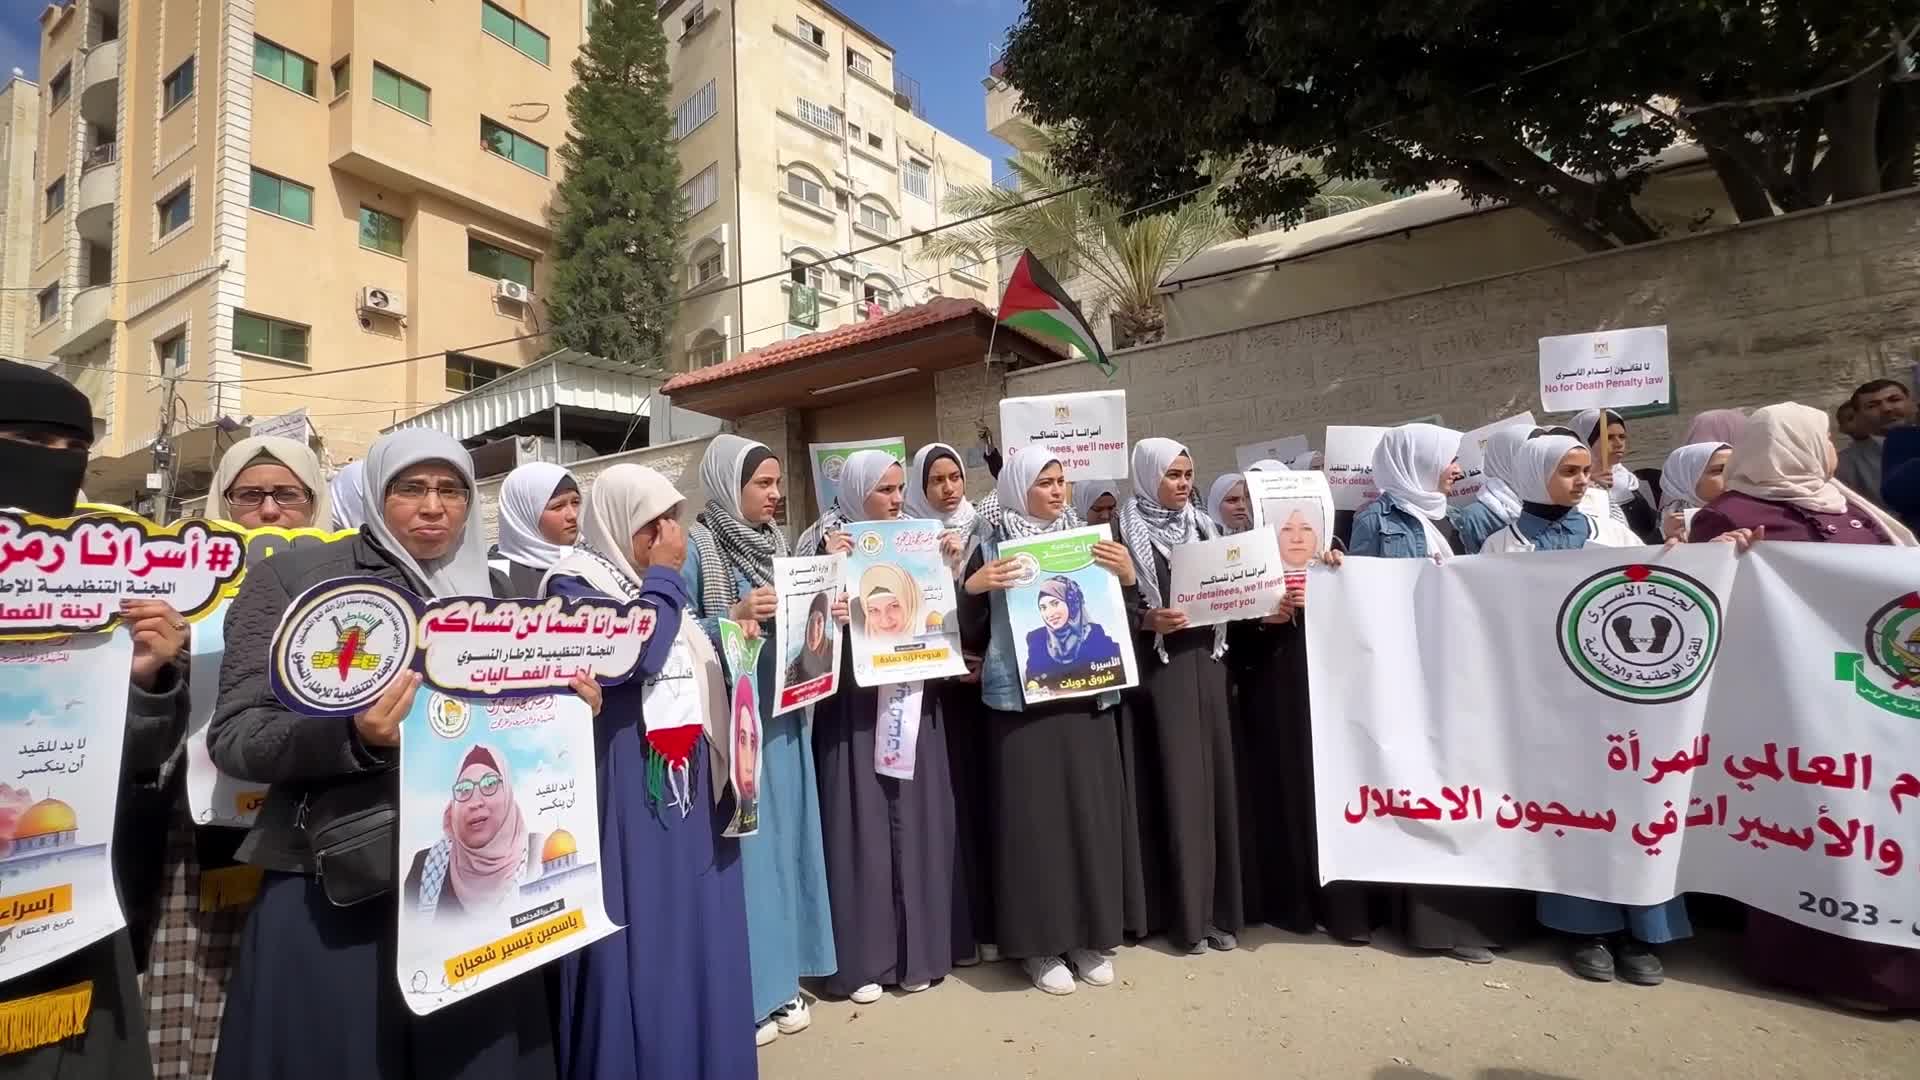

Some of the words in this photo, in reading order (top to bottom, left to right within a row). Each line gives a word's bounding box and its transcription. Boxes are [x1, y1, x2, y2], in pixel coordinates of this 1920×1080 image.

[1614, 362, 1643, 376] لقانون
[1544, 384, 1558, 393] No
[1560, 383, 1575, 392] for
[1576, 381, 1604, 391] Death
[1606, 377, 1645, 389] Penalty
[1645, 376, 1664, 385] law
[1059, 428, 1074, 440] لن
[1076, 443, 1097, 452] we'll
[1098, 441, 1125, 451] never
[1072, 458, 1090, 469] you
[1329, 475, 1347, 485] Sick
[1349, 475, 1375, 485] detain
[1230, 569, 1244, 583] لن
[38, 579, 122, 598] التنظيمية
[126, 580, 176, 598] اللجنة
[1177, 592, 1194, 604] Our
[1196, 585, 1243, 601] detainees,
[1244, 581, 1263, 593] we'll
[1647, 584, 1696, 612] لجنة
[60, 603, 102, 623] لجنة
[1210, 598, 1238, 611] forget
[1238, 597, 1256, 608] you
[1587, 584, 1641, 625] الأسرى
[424, 609, 514, 640] ننساكم
[515, 613, 542, 640] لن
[457, 650, 502, 666] النسوي
[502, 647, 535, 663] للإطار
[536, 645, 585, 662] التنظيمية
[586, 645, 616, 661] اللجنة
[1583, 636, 1633, 682] والإسلامية
[1684, 637, 1703, 667] للقوى
[373, 655, 395, 682] اللجنة
[1090, 655, 1121, 672] الأسيرة
[1635, 662, 1684, 685] الوطنية
[470, 664, 551, 688] الفعاليات
[1059, 678, 1086, 689] دويات
[1088, 671, 1115, 686] شروق
[333, 677, 377, 701] التنظيمية
[18, 739, 57, 758] للقيد
[60, 741, 74, 754] بد
[77, 737, 87, 749] لا
[68, 753, 86, 774] أن
[1607, 729, 1710, 784] للمرأة
[16, 759, 66, 779] ينكسر
[1723, 742, 1873, 792] العالمي
[535, 783, 558, 798] للقيد
[566, 791, 576, 808] أن
[537, 798, 566, 815] ينكسر
[1345, 785, 1483, 824] الاحتلال
[1495, 793, 1617, 838] سجون
[1632, 800, 1678, 857] في
[1685, 794, 1904, 877] والأسيرات
[1798, 890, 1879, 926] 2023
[536, 915, 578, 945] ياسمين
[501, 932, 534, 960] تيسير
[453, 947, 497, 978] شعبان
